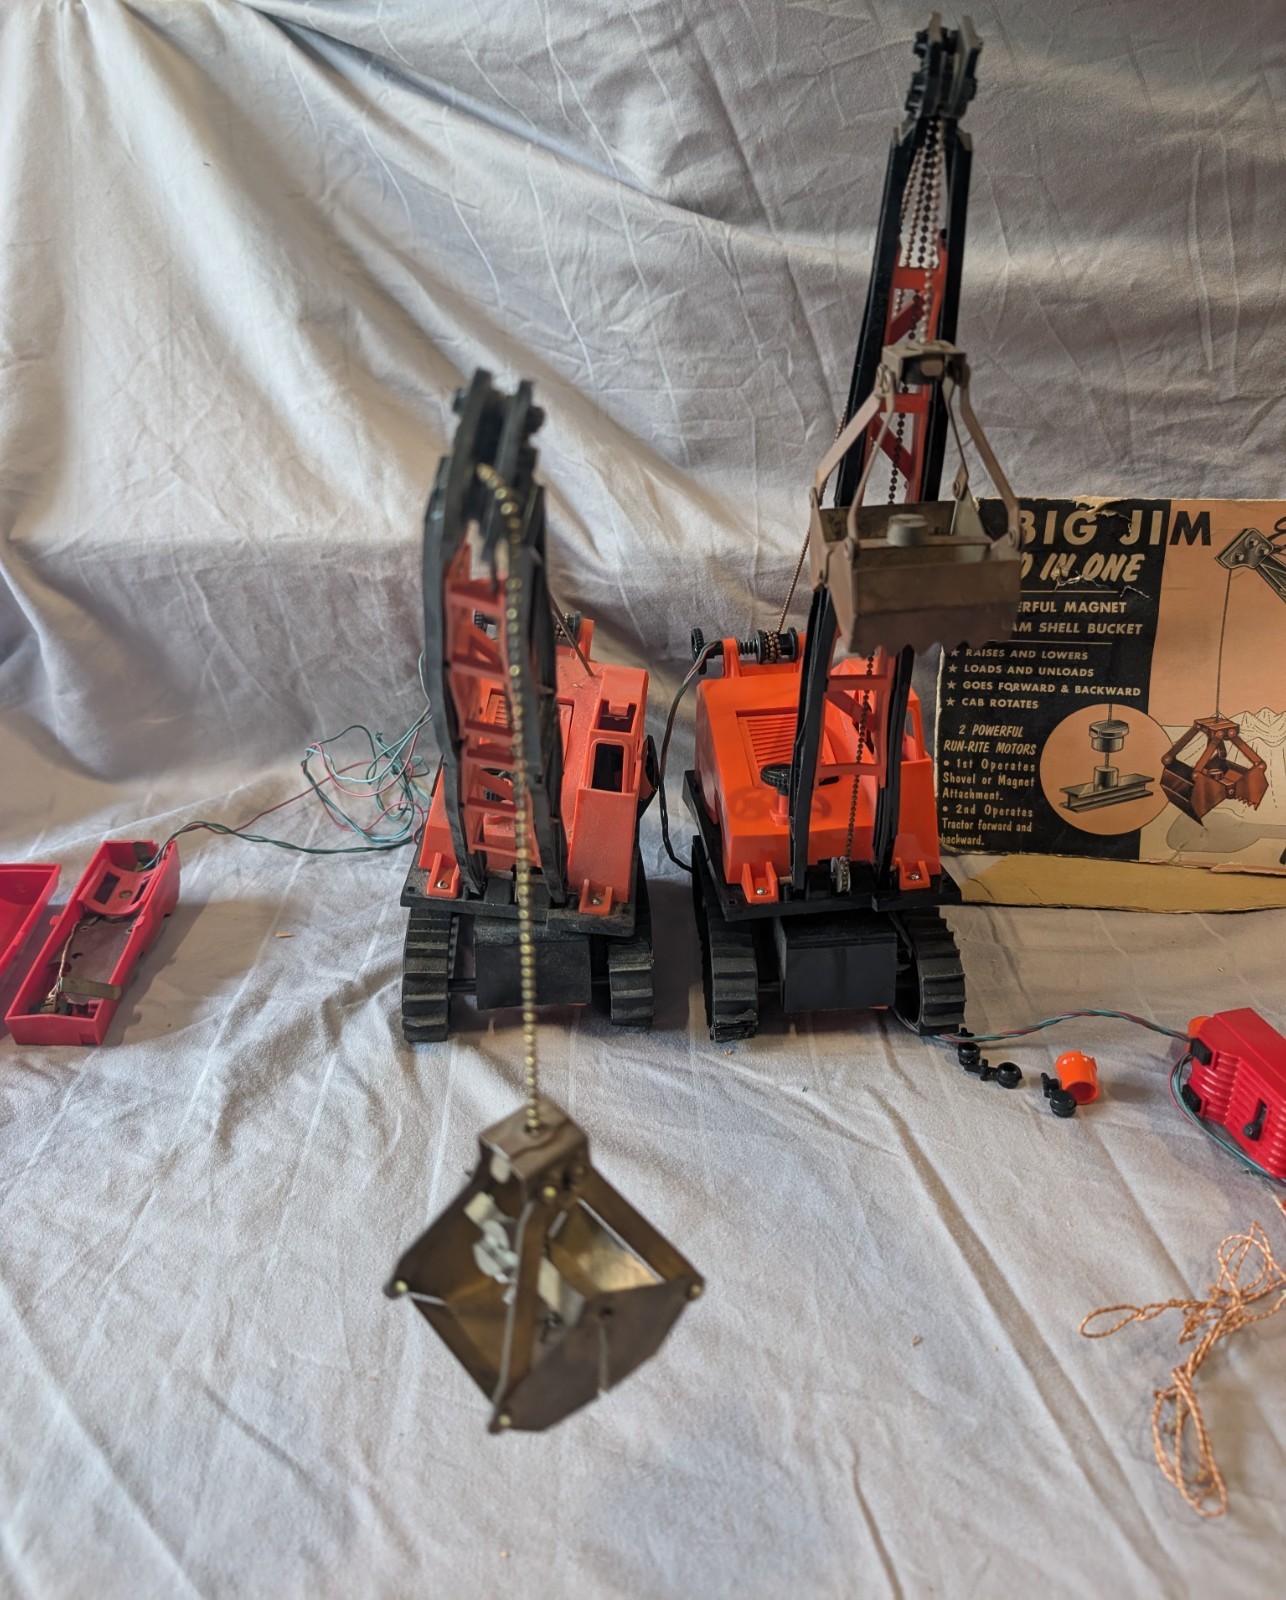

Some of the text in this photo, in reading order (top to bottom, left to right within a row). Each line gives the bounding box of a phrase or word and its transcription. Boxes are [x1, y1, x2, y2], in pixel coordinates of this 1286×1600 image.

[1019, 509, 1212, 546] BIG JIM
[1040, 552, 1077, 582] IN
[1082, 552, 1146, 583] ONE
[1018, 601, 1127, 614] ERFUL MAGNET
[1038, 622, 1080, 634] SHELL
[1087, 623, 1143, 635] BUCKET
[965, 648, 1089, 660] RAISES AND LOWERS
[964, 664, 1095, 677] LOADS AND UNLOADS
[962, 680, 1141, 697] GOES FORWARD & BACKWARD
[961, 697, 1040, 710] CAB ROTATES
[958, 723, 1024, 738] 2 POWERFUL
[943, 739, 1037, 756] RUN-RITE MOTORS
[956, 758, 1036, 773] 1st Operates
[942, 771, 1035, 789] Shovel or Magnet
[942, 787, 1004, 801] Attachment.
[955, 803, 1034, 819] 2nd Operates
[942, 817, 1033, 833] Tractor forward and
[940, 833, 985, 846] backward.
